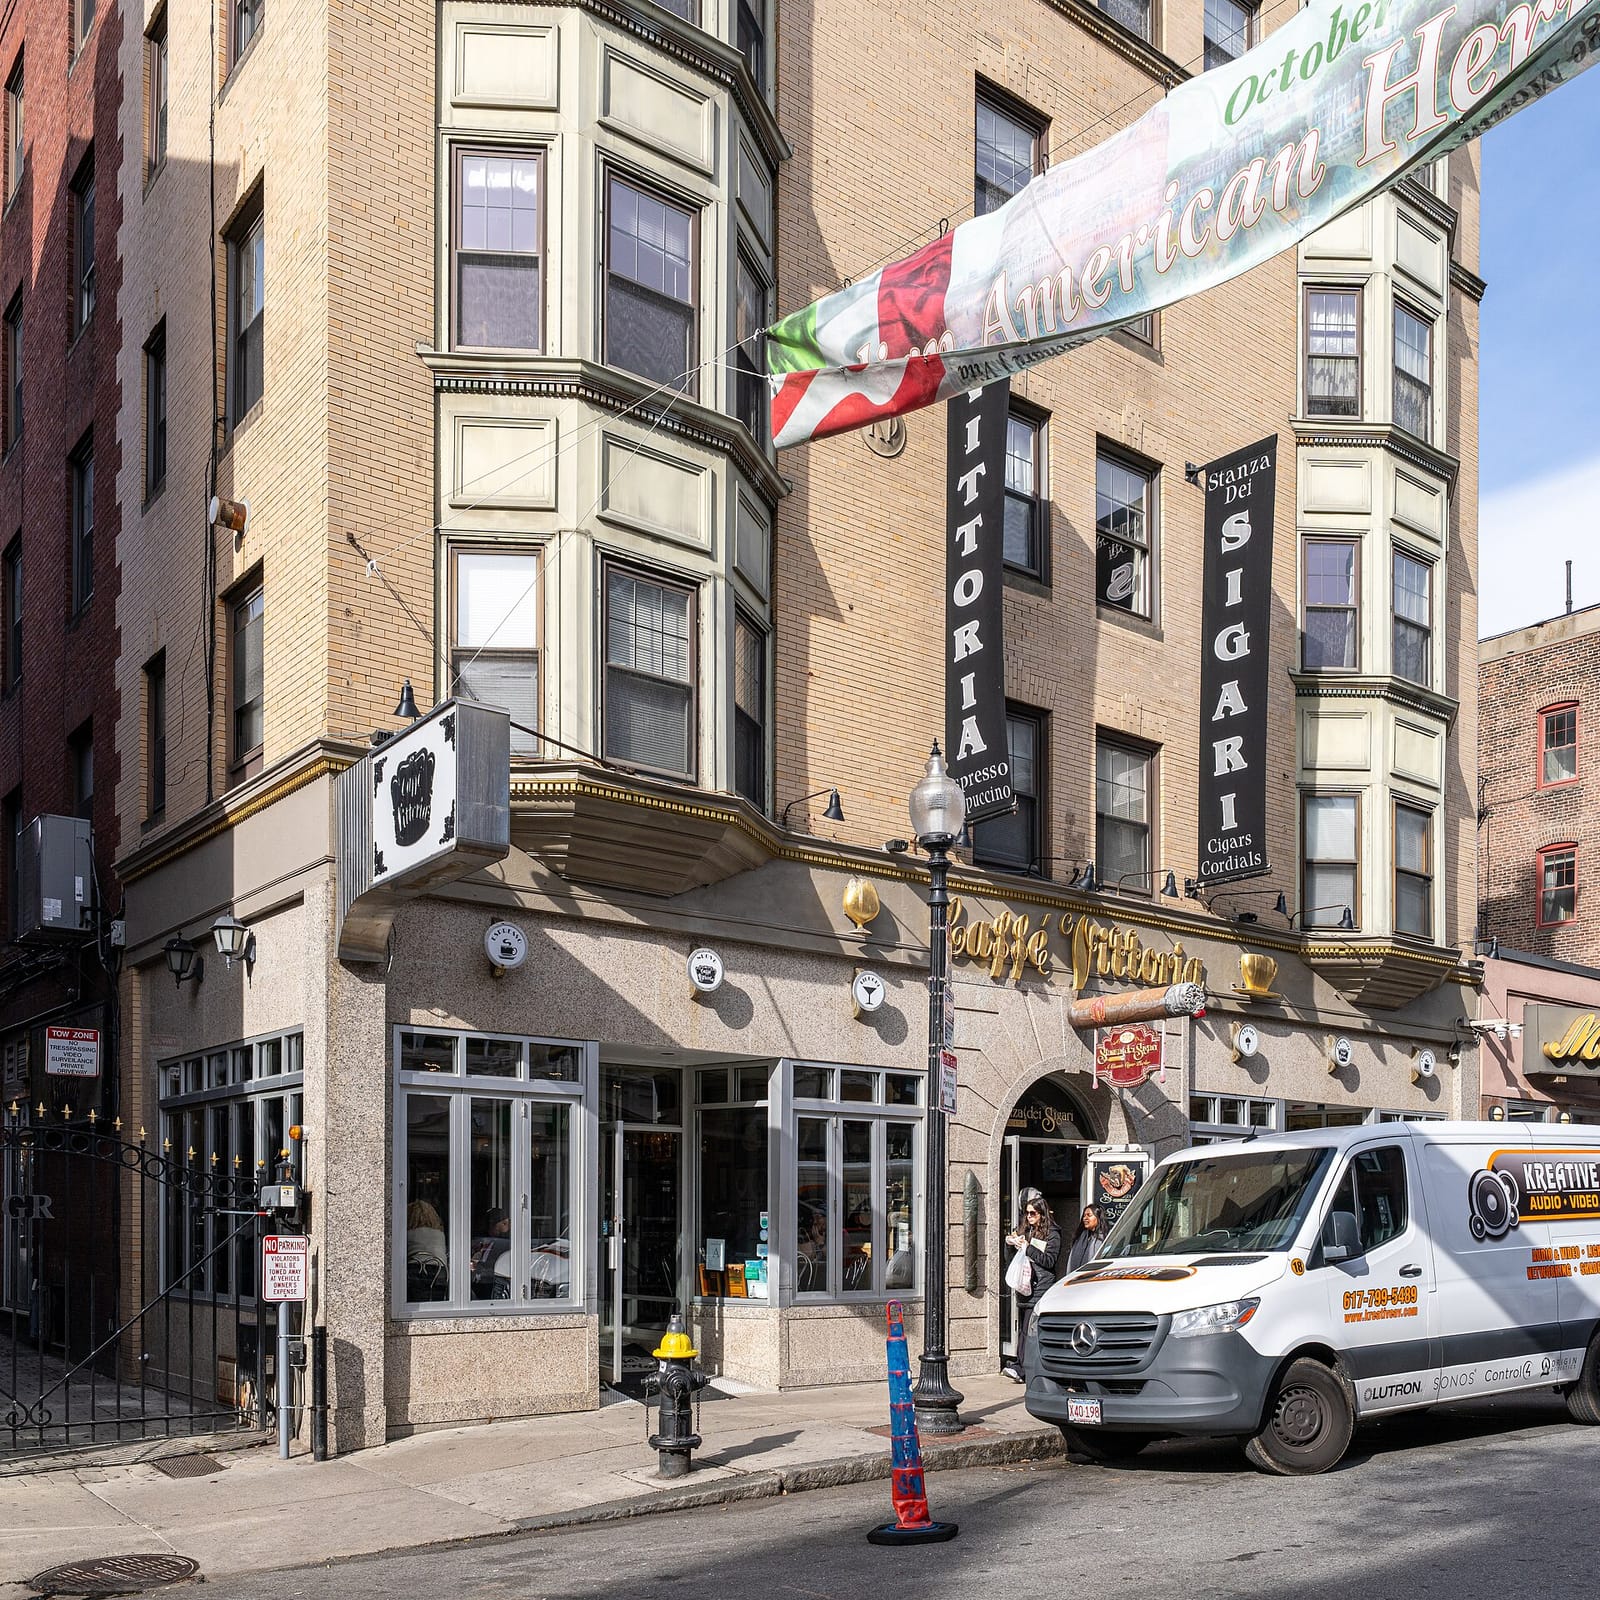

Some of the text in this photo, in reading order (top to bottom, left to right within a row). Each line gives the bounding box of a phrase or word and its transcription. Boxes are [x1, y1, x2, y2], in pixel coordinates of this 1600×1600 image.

[1224, 0, 1391, 126] October
[982, 128, 1326, 346] American
[1208, 455, 1271, 492] Stanza
[1224, 478, 1252, 505] Dei
[953, 387, 988, 761] ITTORIA
[1212, 510, 1252, 831] SIGARI
[1207, 833, 1252, 854] Cigars
[1201, 851, 1262, 876] Cordials
[1059, 912, 1204, 990] Vittoria
[1522, 1162, 1600, 1192] KREATIVE
[1530, 1193, 1599, 1210] AUDIO VIDEO
[266, 1240, 305, 1252] NO PARKING
[1532, 1247, 1553, 1262] AUDIO
[1559, 1246, 1580, 1260] VIDEO
[1293, 1261, 1303, 1273] 18
[1343, 1285, 1418, 1310] 617-799-5489
[1372, 1381, 1422, 1400] LUTRON
[1433, 1371, 1475, 1391] SONOS
